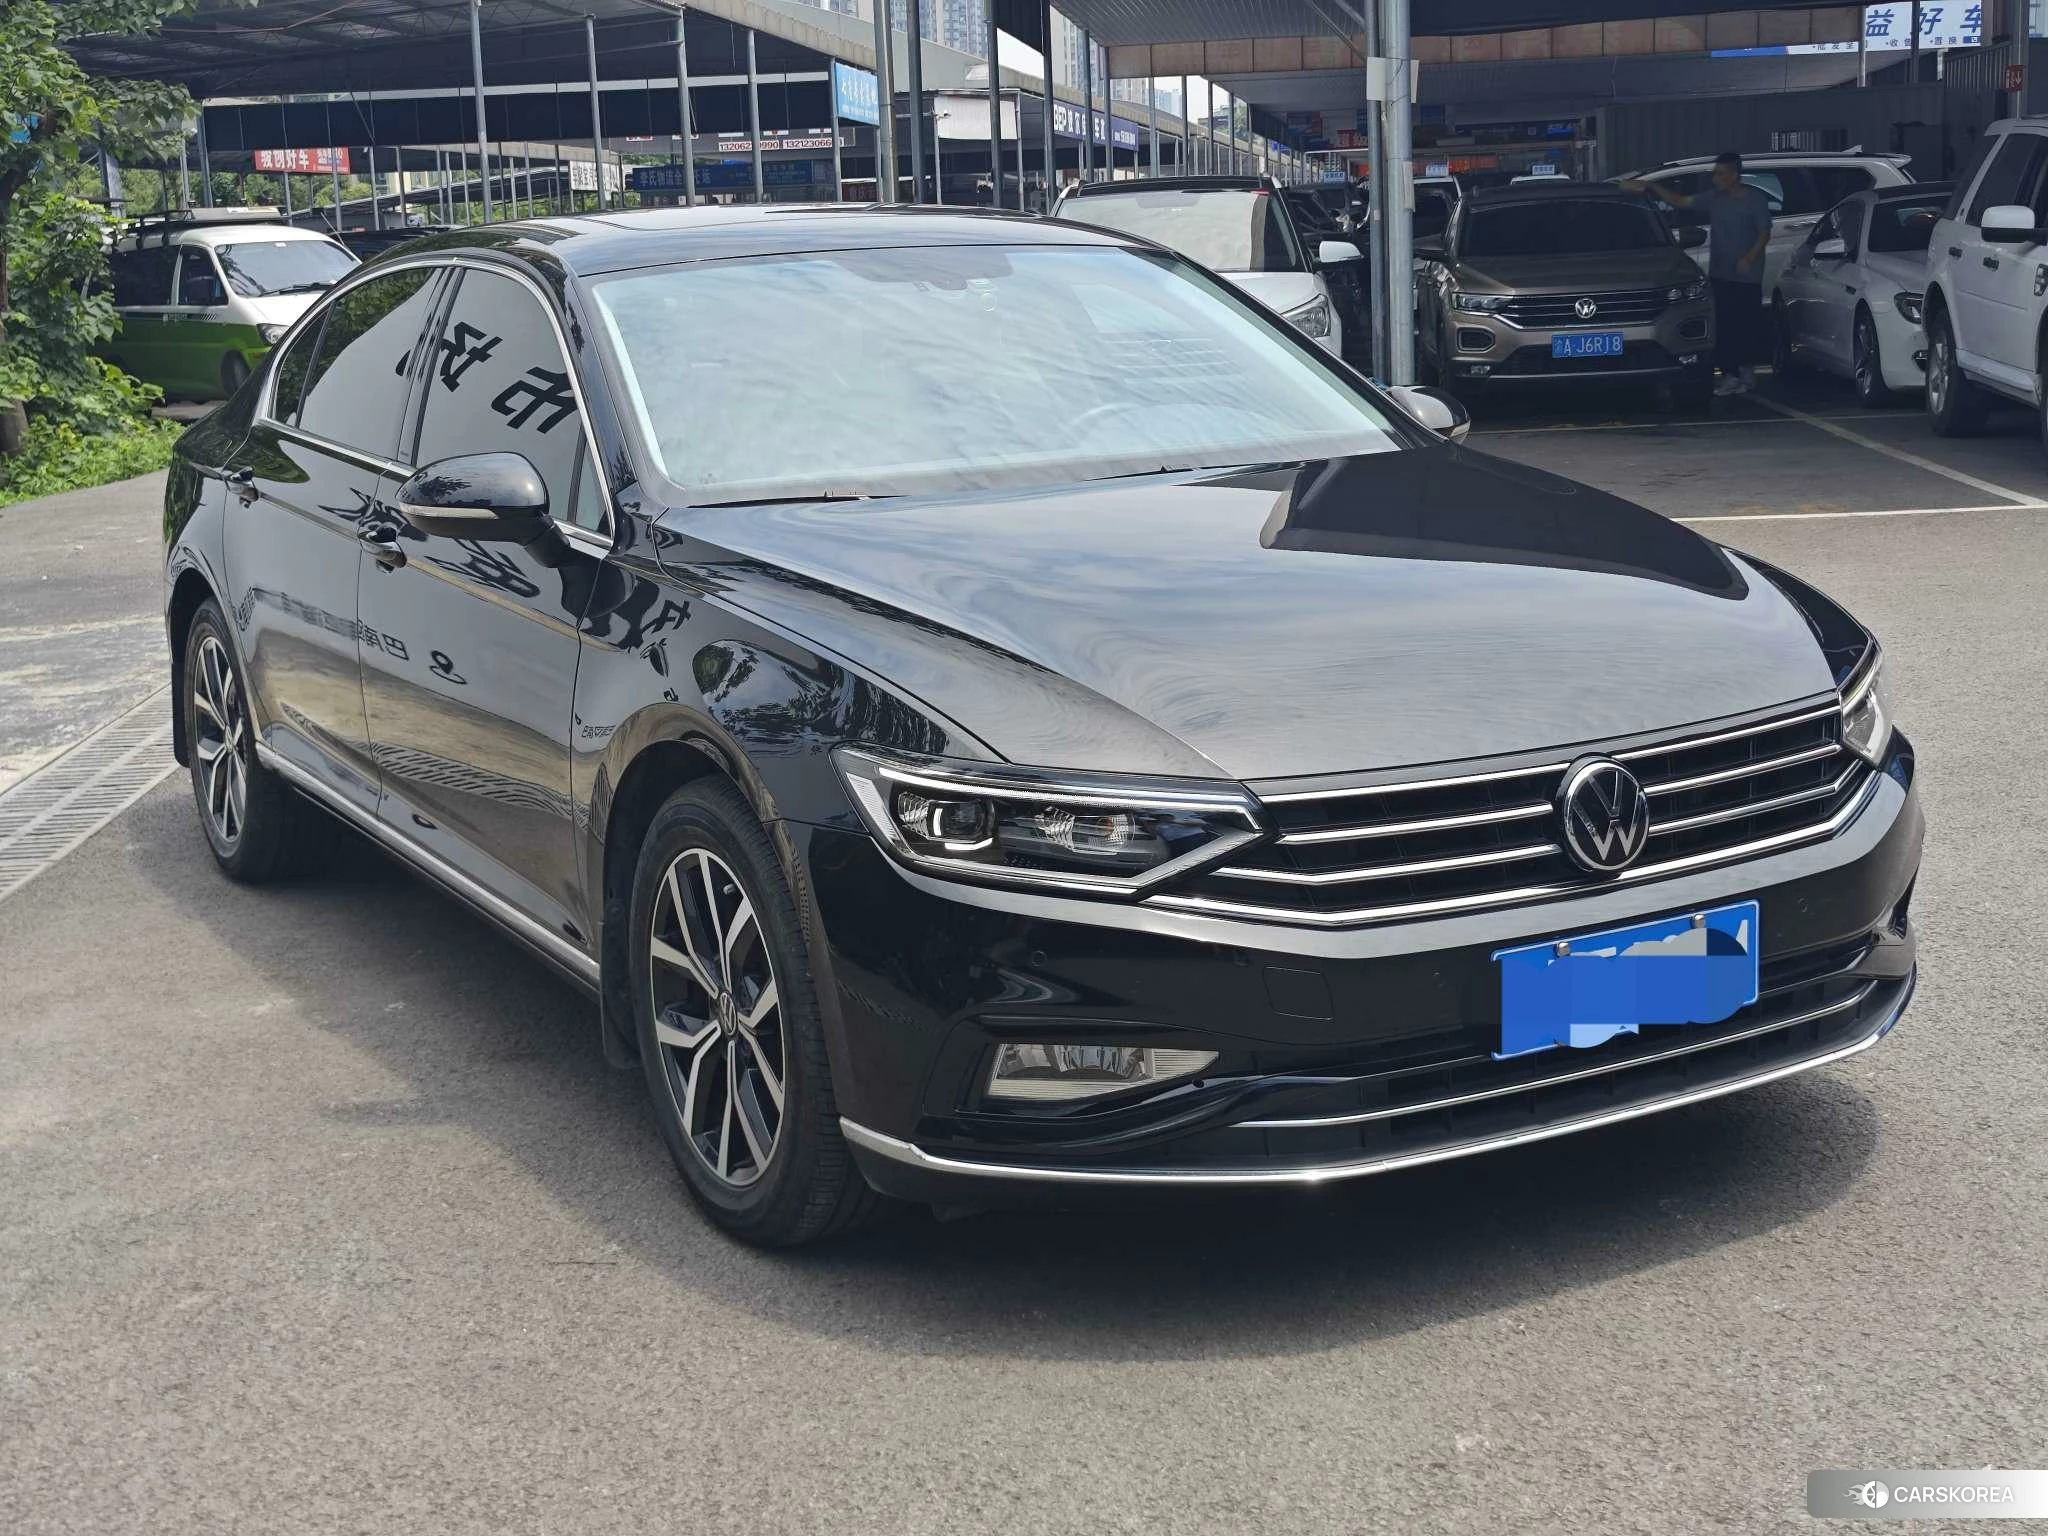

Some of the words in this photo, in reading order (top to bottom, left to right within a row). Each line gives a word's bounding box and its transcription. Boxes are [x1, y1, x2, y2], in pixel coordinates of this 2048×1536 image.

[720, 140, 779, 151] 132062990
[785, 138, 843, 148] 132123066
[1564, 761, 1650, 870] VW
